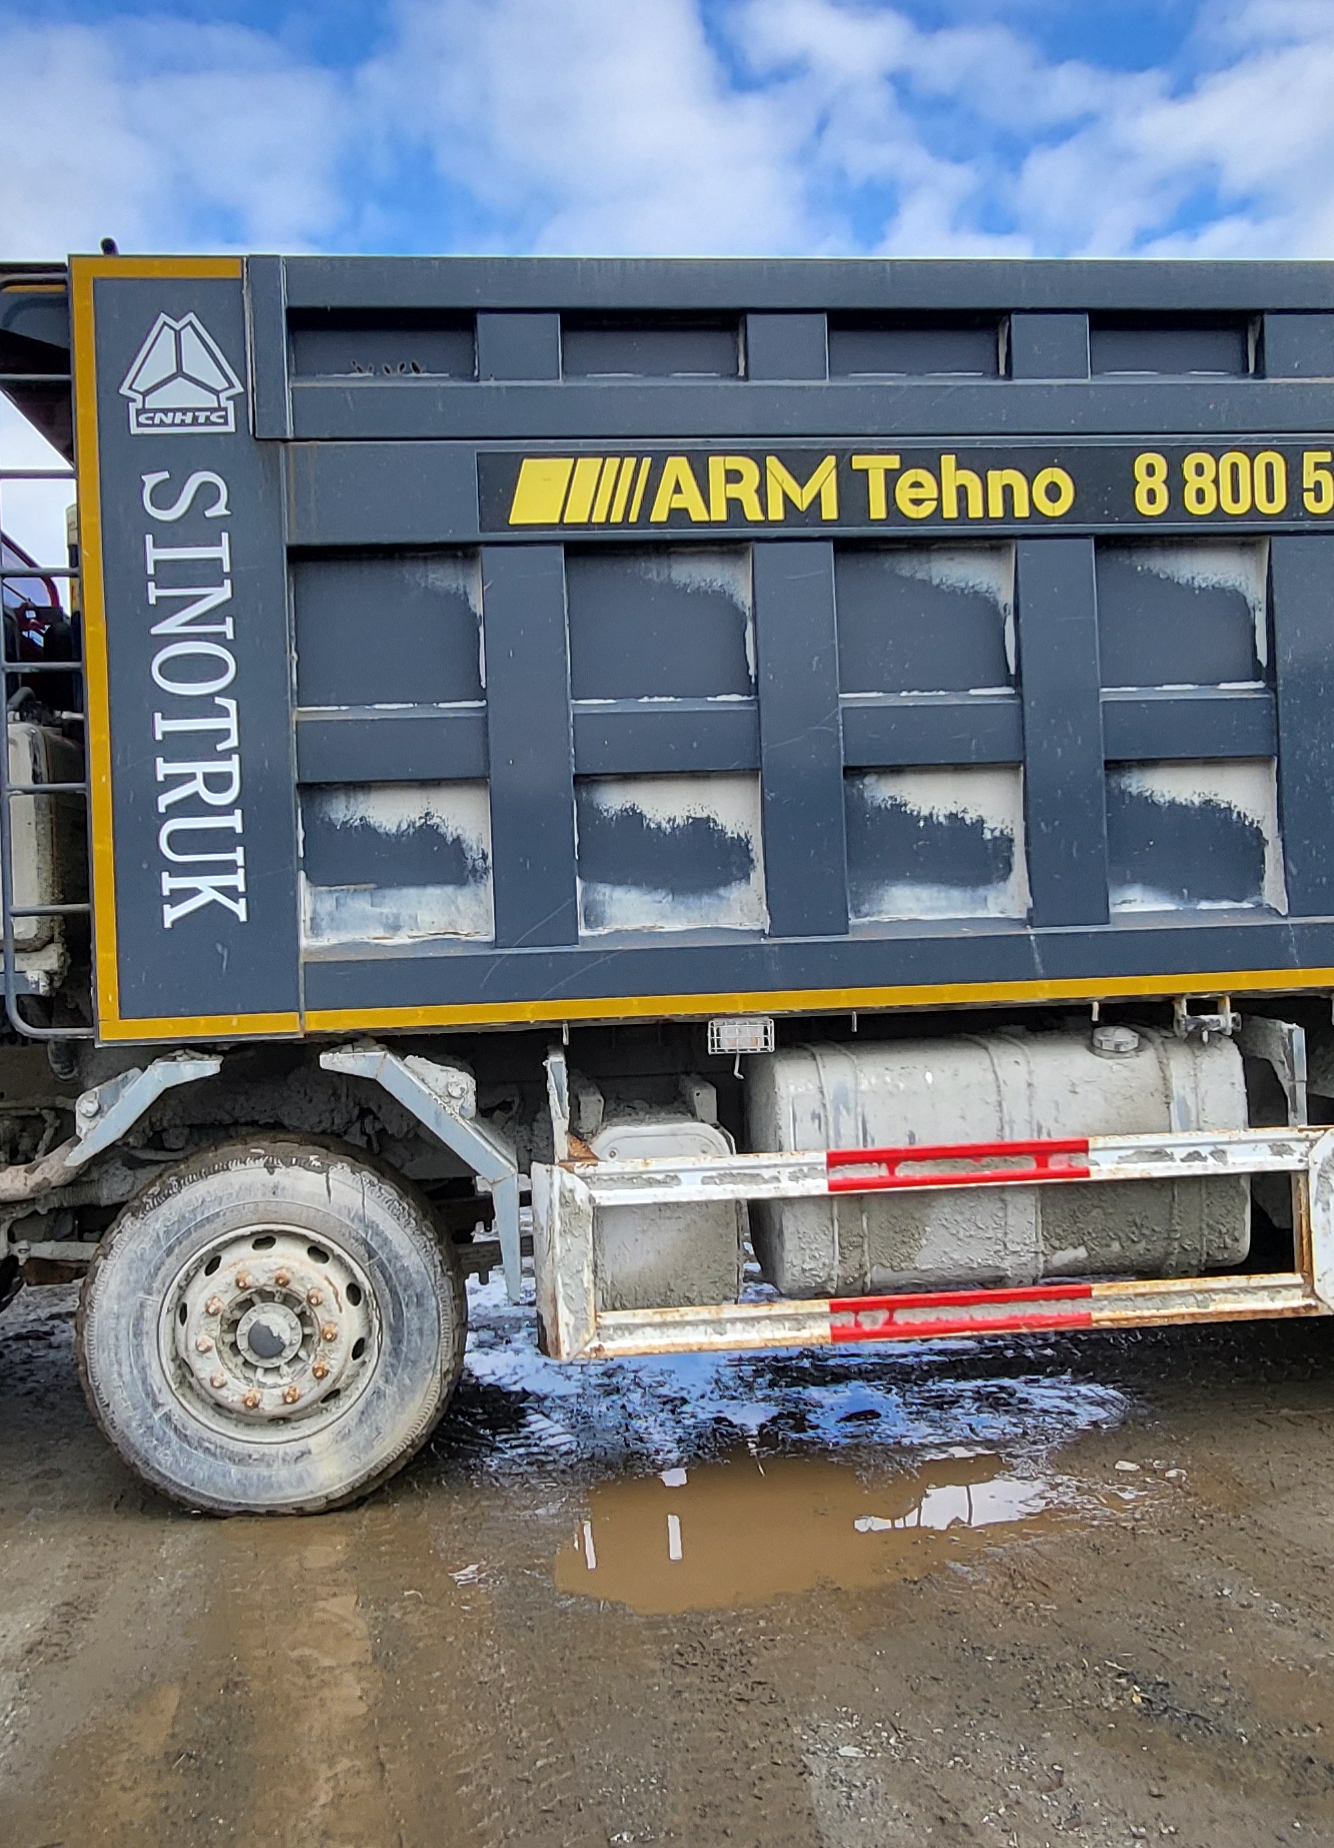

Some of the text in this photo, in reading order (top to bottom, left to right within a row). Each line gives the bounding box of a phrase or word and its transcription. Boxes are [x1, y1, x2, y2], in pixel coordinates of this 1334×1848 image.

[137, 410, 226, 425] CNHTC
[649, 454, 1076, 522] ARM Tehno
[1133, 453, 1168, 516] 8
[1181, 450, 1288, 516] 800
[140, 469, 248, 928] SINOTRUK
